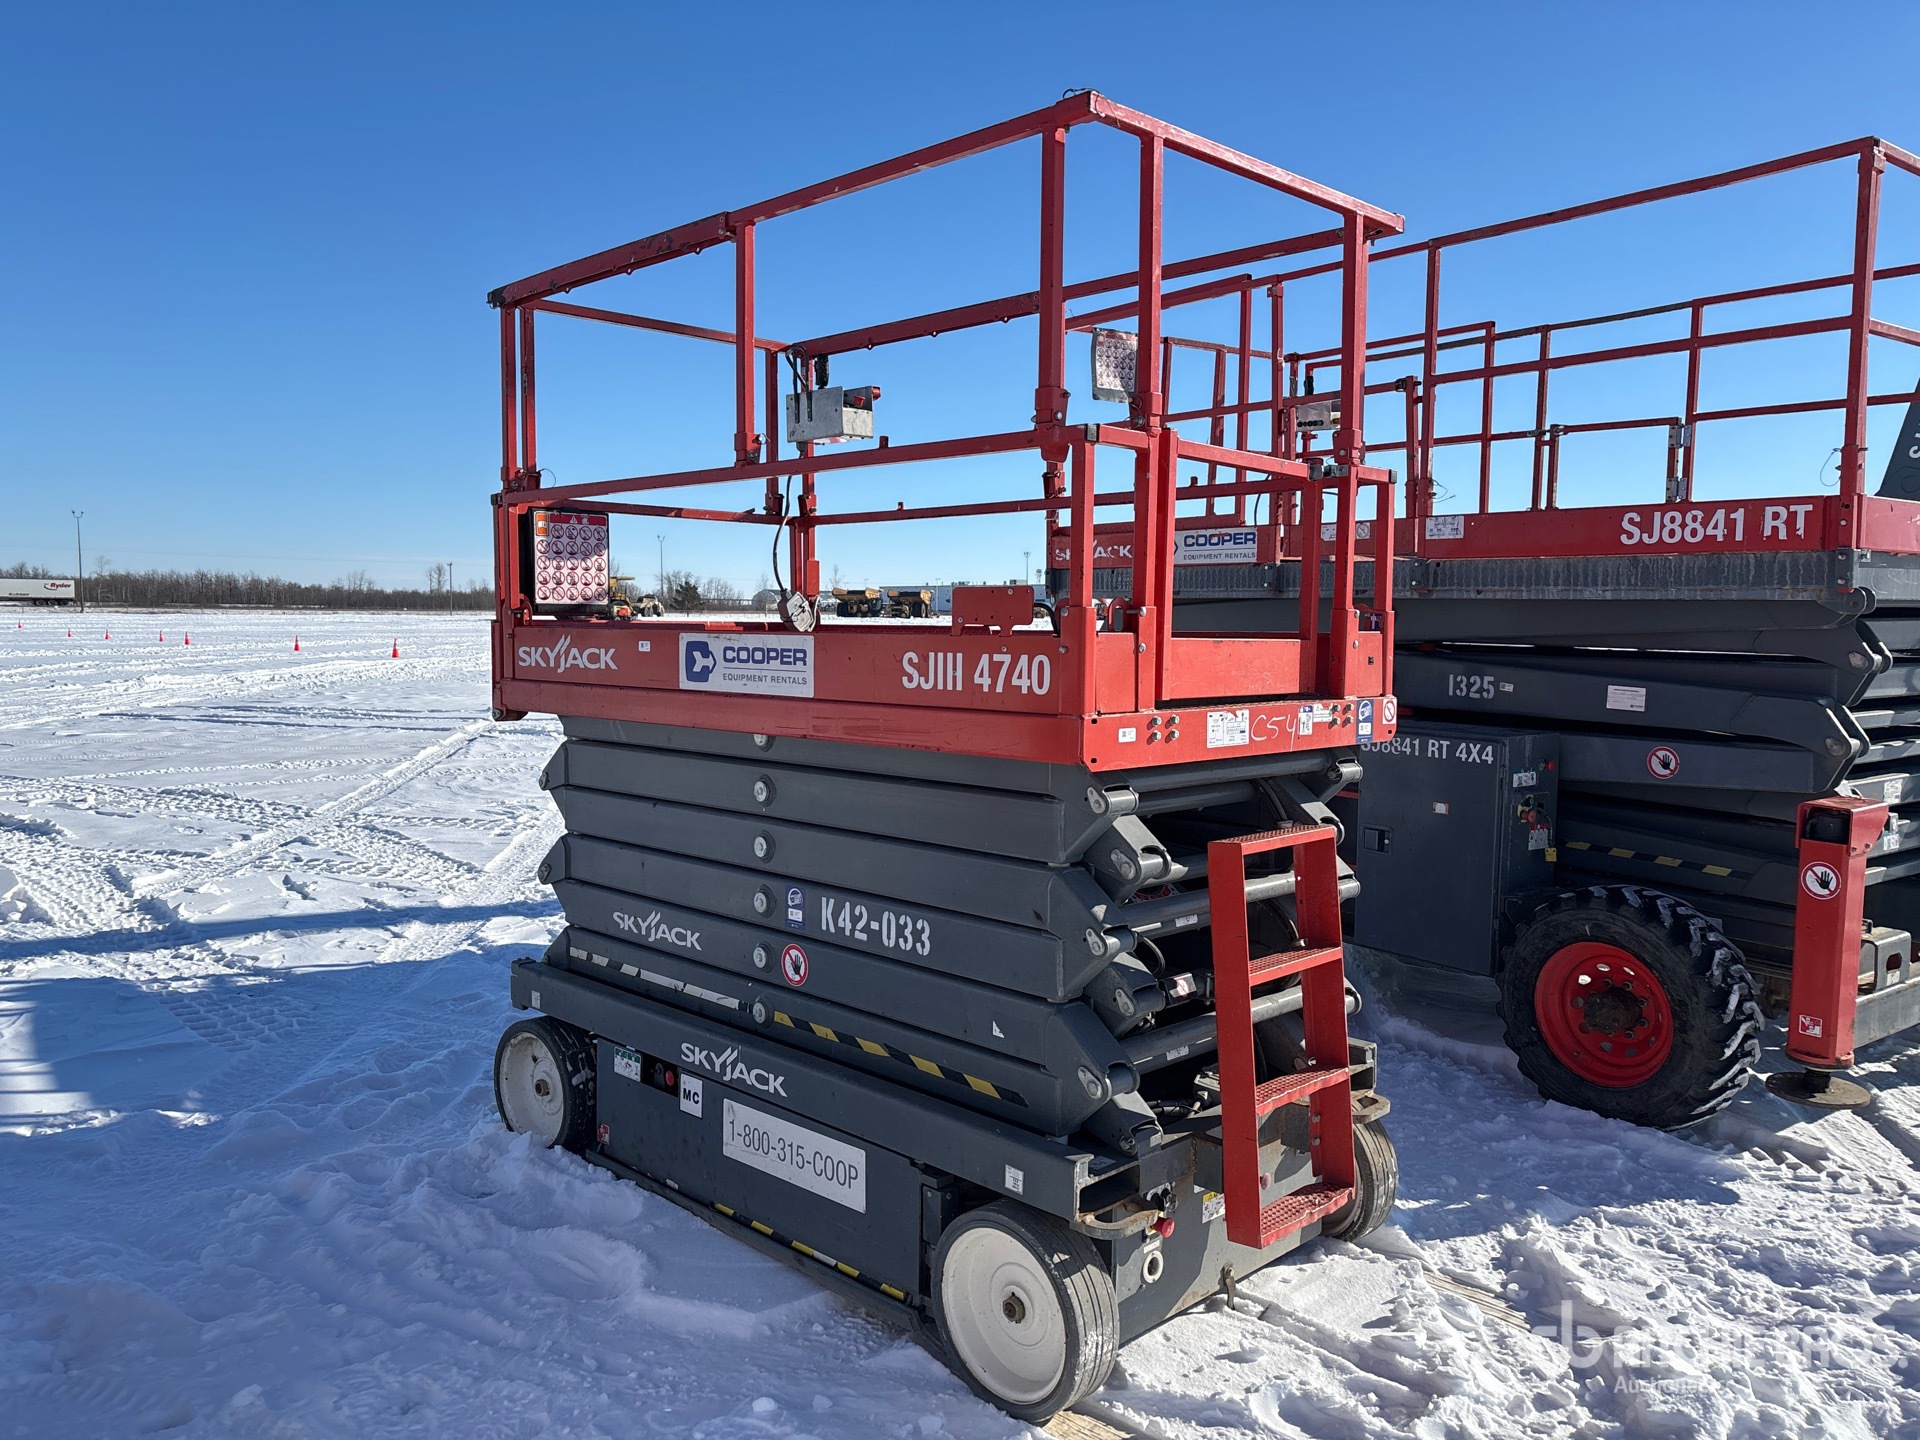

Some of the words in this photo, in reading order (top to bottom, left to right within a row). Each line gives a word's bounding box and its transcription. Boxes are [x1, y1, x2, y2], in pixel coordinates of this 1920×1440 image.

[1183, 532, 1257, 547] COOPER
[1620, 508, 1745, 545] SJ8841
[1763, 504, 1814, 540] RT
[1224, 551, 1256, 559] RENTALS
[518, 634, 618, 673] SKYJACK
[722, 645, 807, 666] COOPER
[722, 672, 767, 683] EQUIPMENT
[770, 674, 807, 685] RENTALS
[974, 653, 1051, 695] 4740
[1427, 739, 1450, 760] RT
[1455, 742, 1494, 765] 4X4
[612, 910, 702, 951] SKYJACK
[821, 897, 931, 957] K42-033
[680, 1042, 788, 1098] SKYJACK
[683, 1087, 700, 1105] MC
[729, 1118, 858, 1189] 1-800-315-COOP
